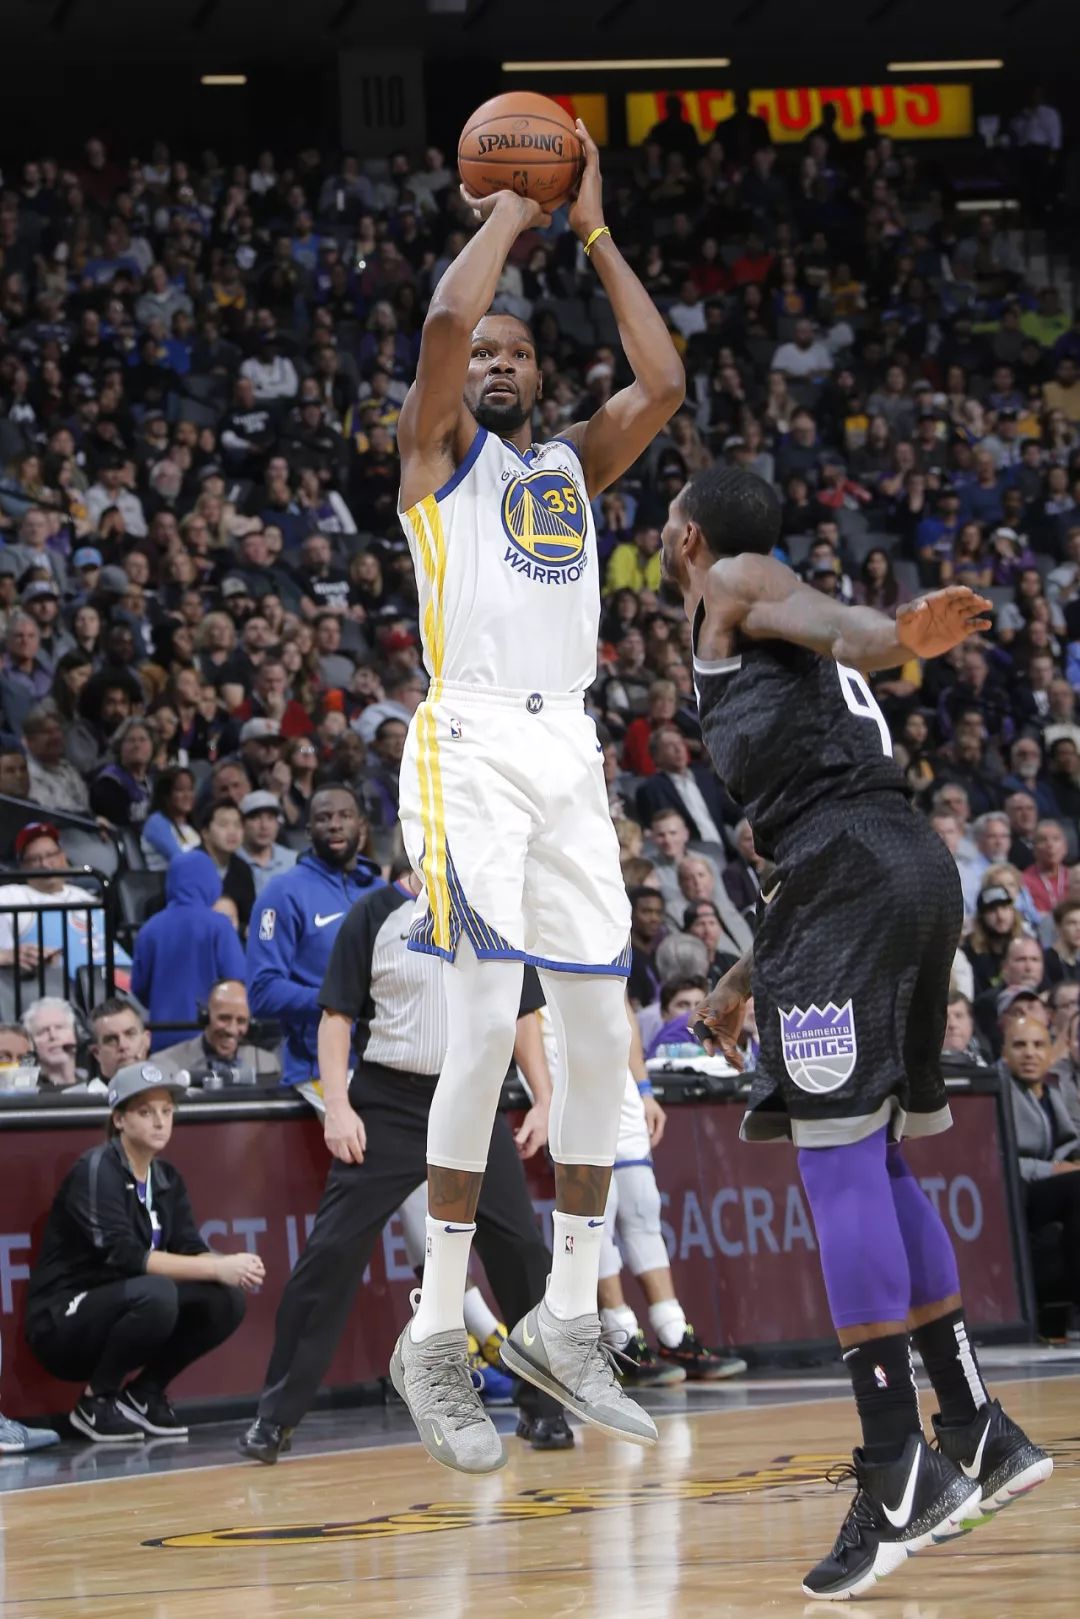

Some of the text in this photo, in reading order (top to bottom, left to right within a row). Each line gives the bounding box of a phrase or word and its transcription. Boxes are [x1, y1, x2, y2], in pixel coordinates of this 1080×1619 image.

[478, 134, 564, 157] SPALDING
[542, 487, 577, 515] 35
[504, 546, 588, 585] WARRIORS
[837, 661, 893, 759] 9
[785, 1026, 849, 1040] SACRAMENTO
[785, 1038, 853, 1061] KINGS
[660, 1174, 983, 1260] SACRATO
